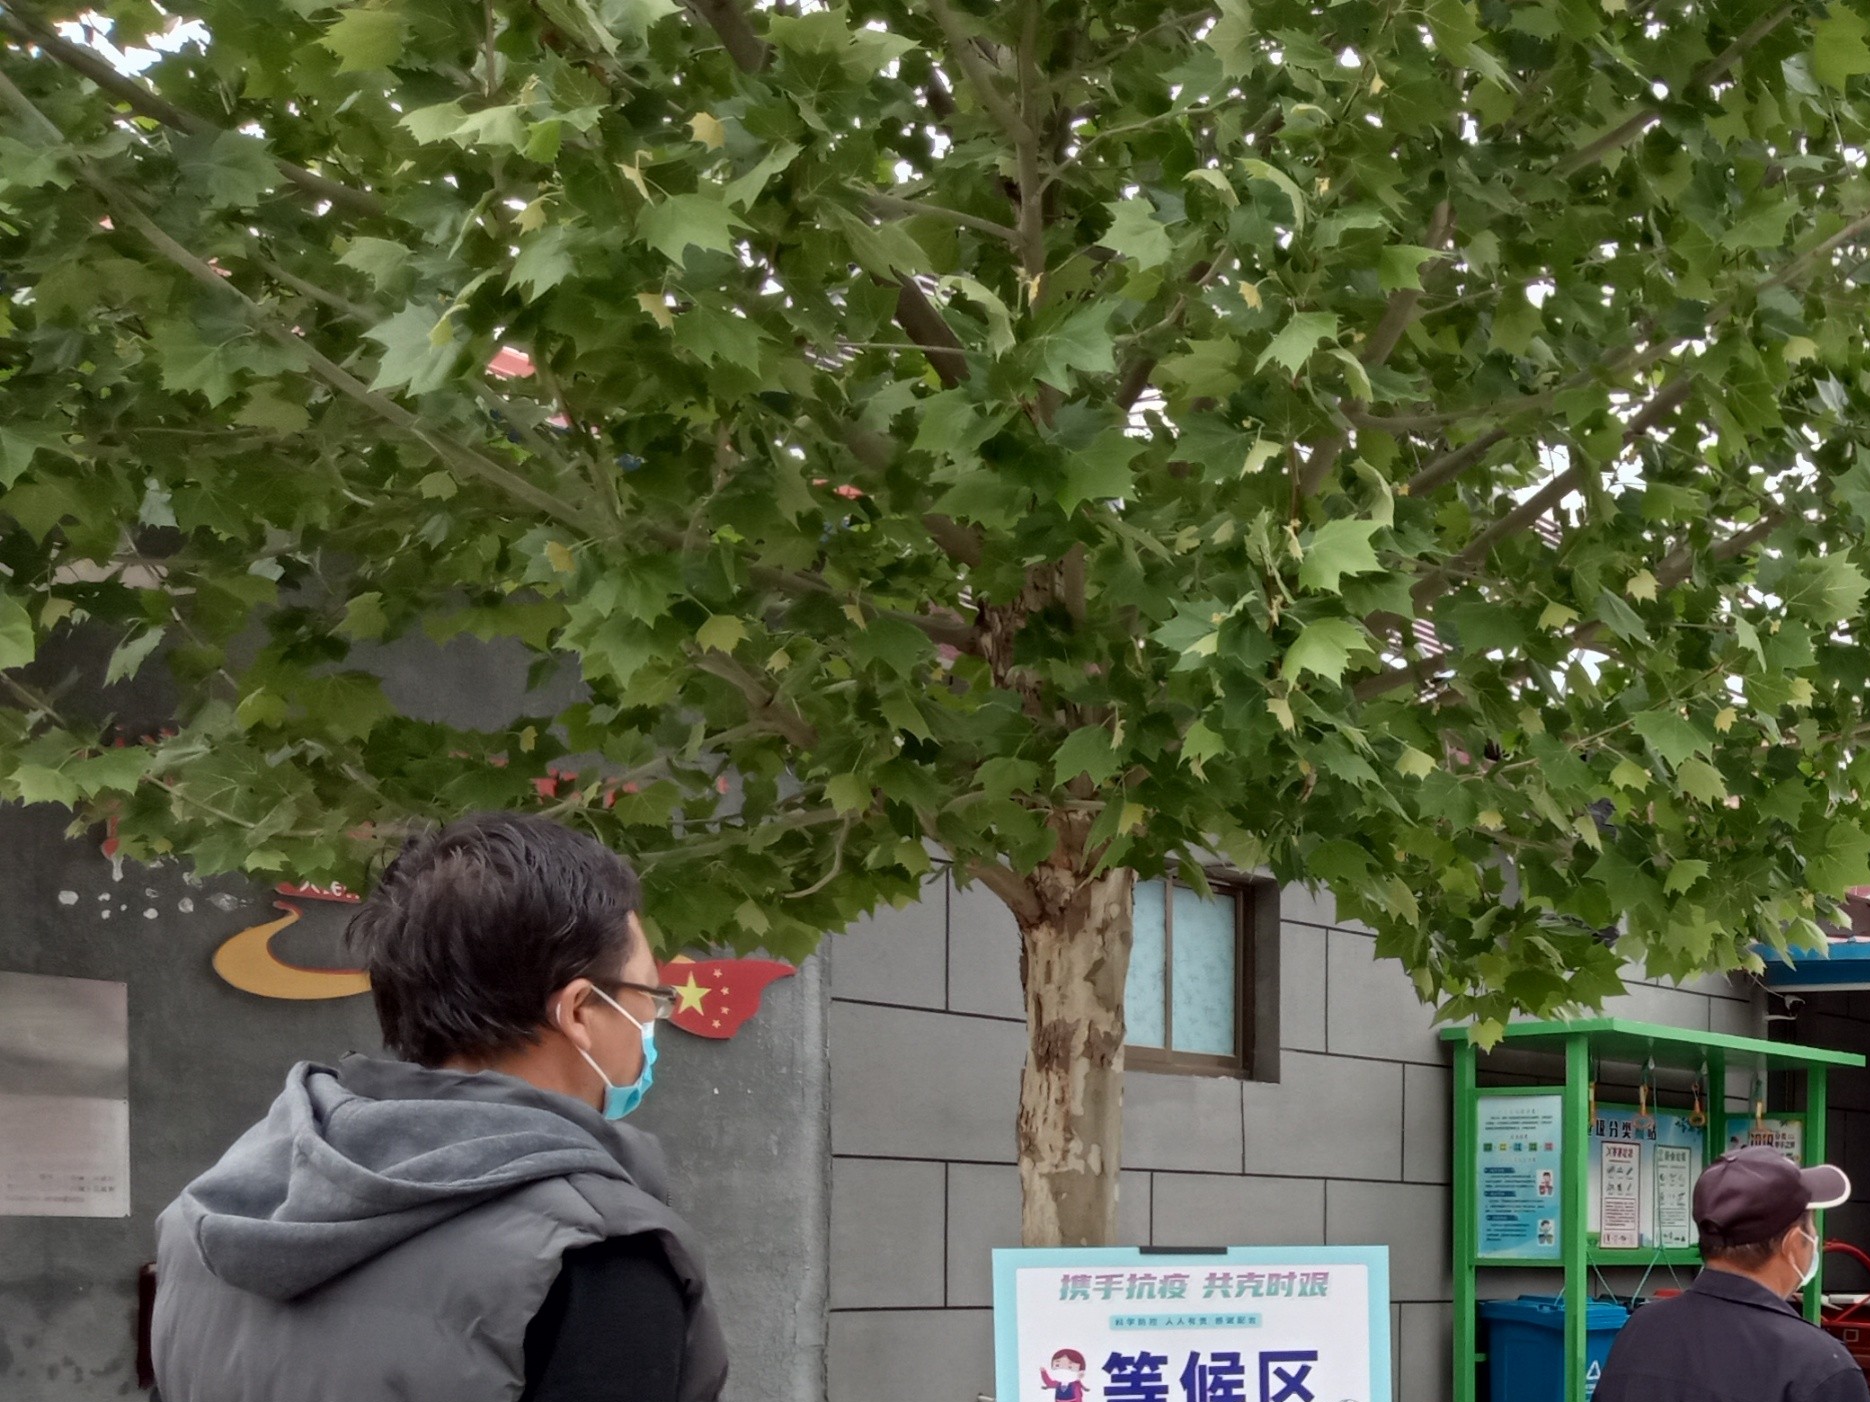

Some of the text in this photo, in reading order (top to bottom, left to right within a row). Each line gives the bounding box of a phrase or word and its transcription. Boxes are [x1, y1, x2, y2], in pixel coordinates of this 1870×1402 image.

[1059, 1271, 1330, 1301] 携手抗疫 共克时艰
